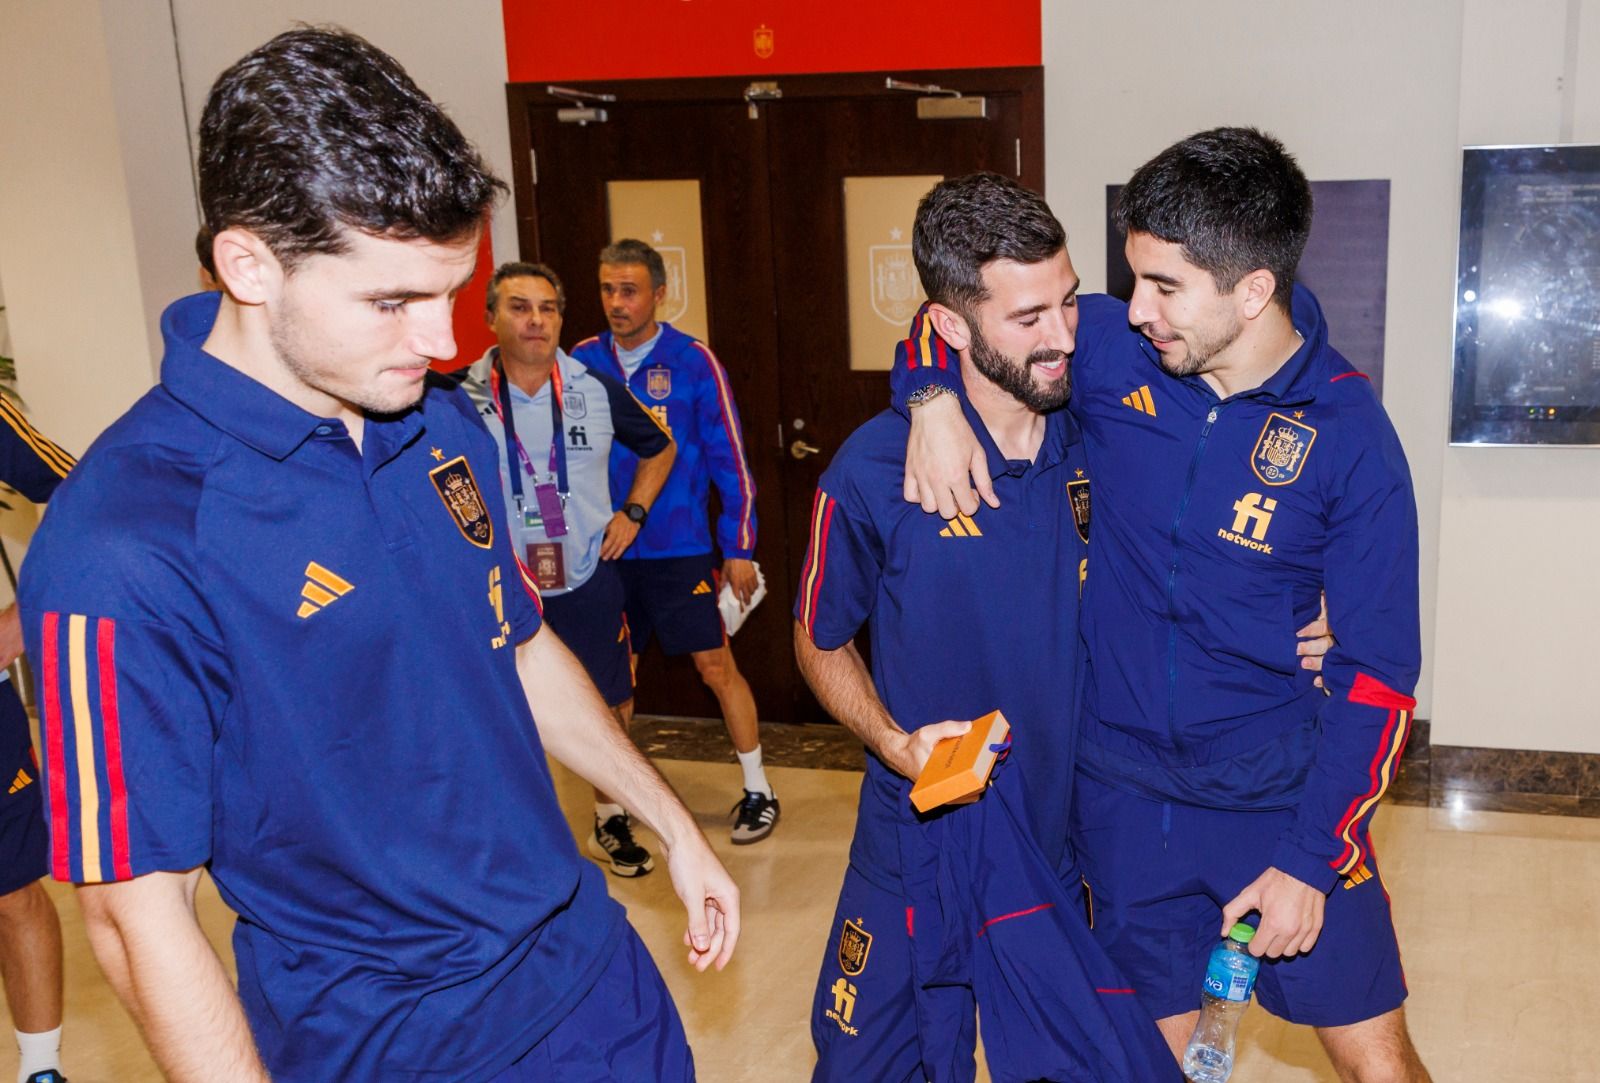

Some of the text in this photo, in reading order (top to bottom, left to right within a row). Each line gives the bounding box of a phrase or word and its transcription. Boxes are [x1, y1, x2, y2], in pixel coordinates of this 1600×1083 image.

[568, 426, 588, 446] fi
[1232, 492, 1278, 542] fi
[1217, 527, 1274, 555] network
[1205, 975, 1223, 991] wa
[831, 977, 858, 1024] fi
